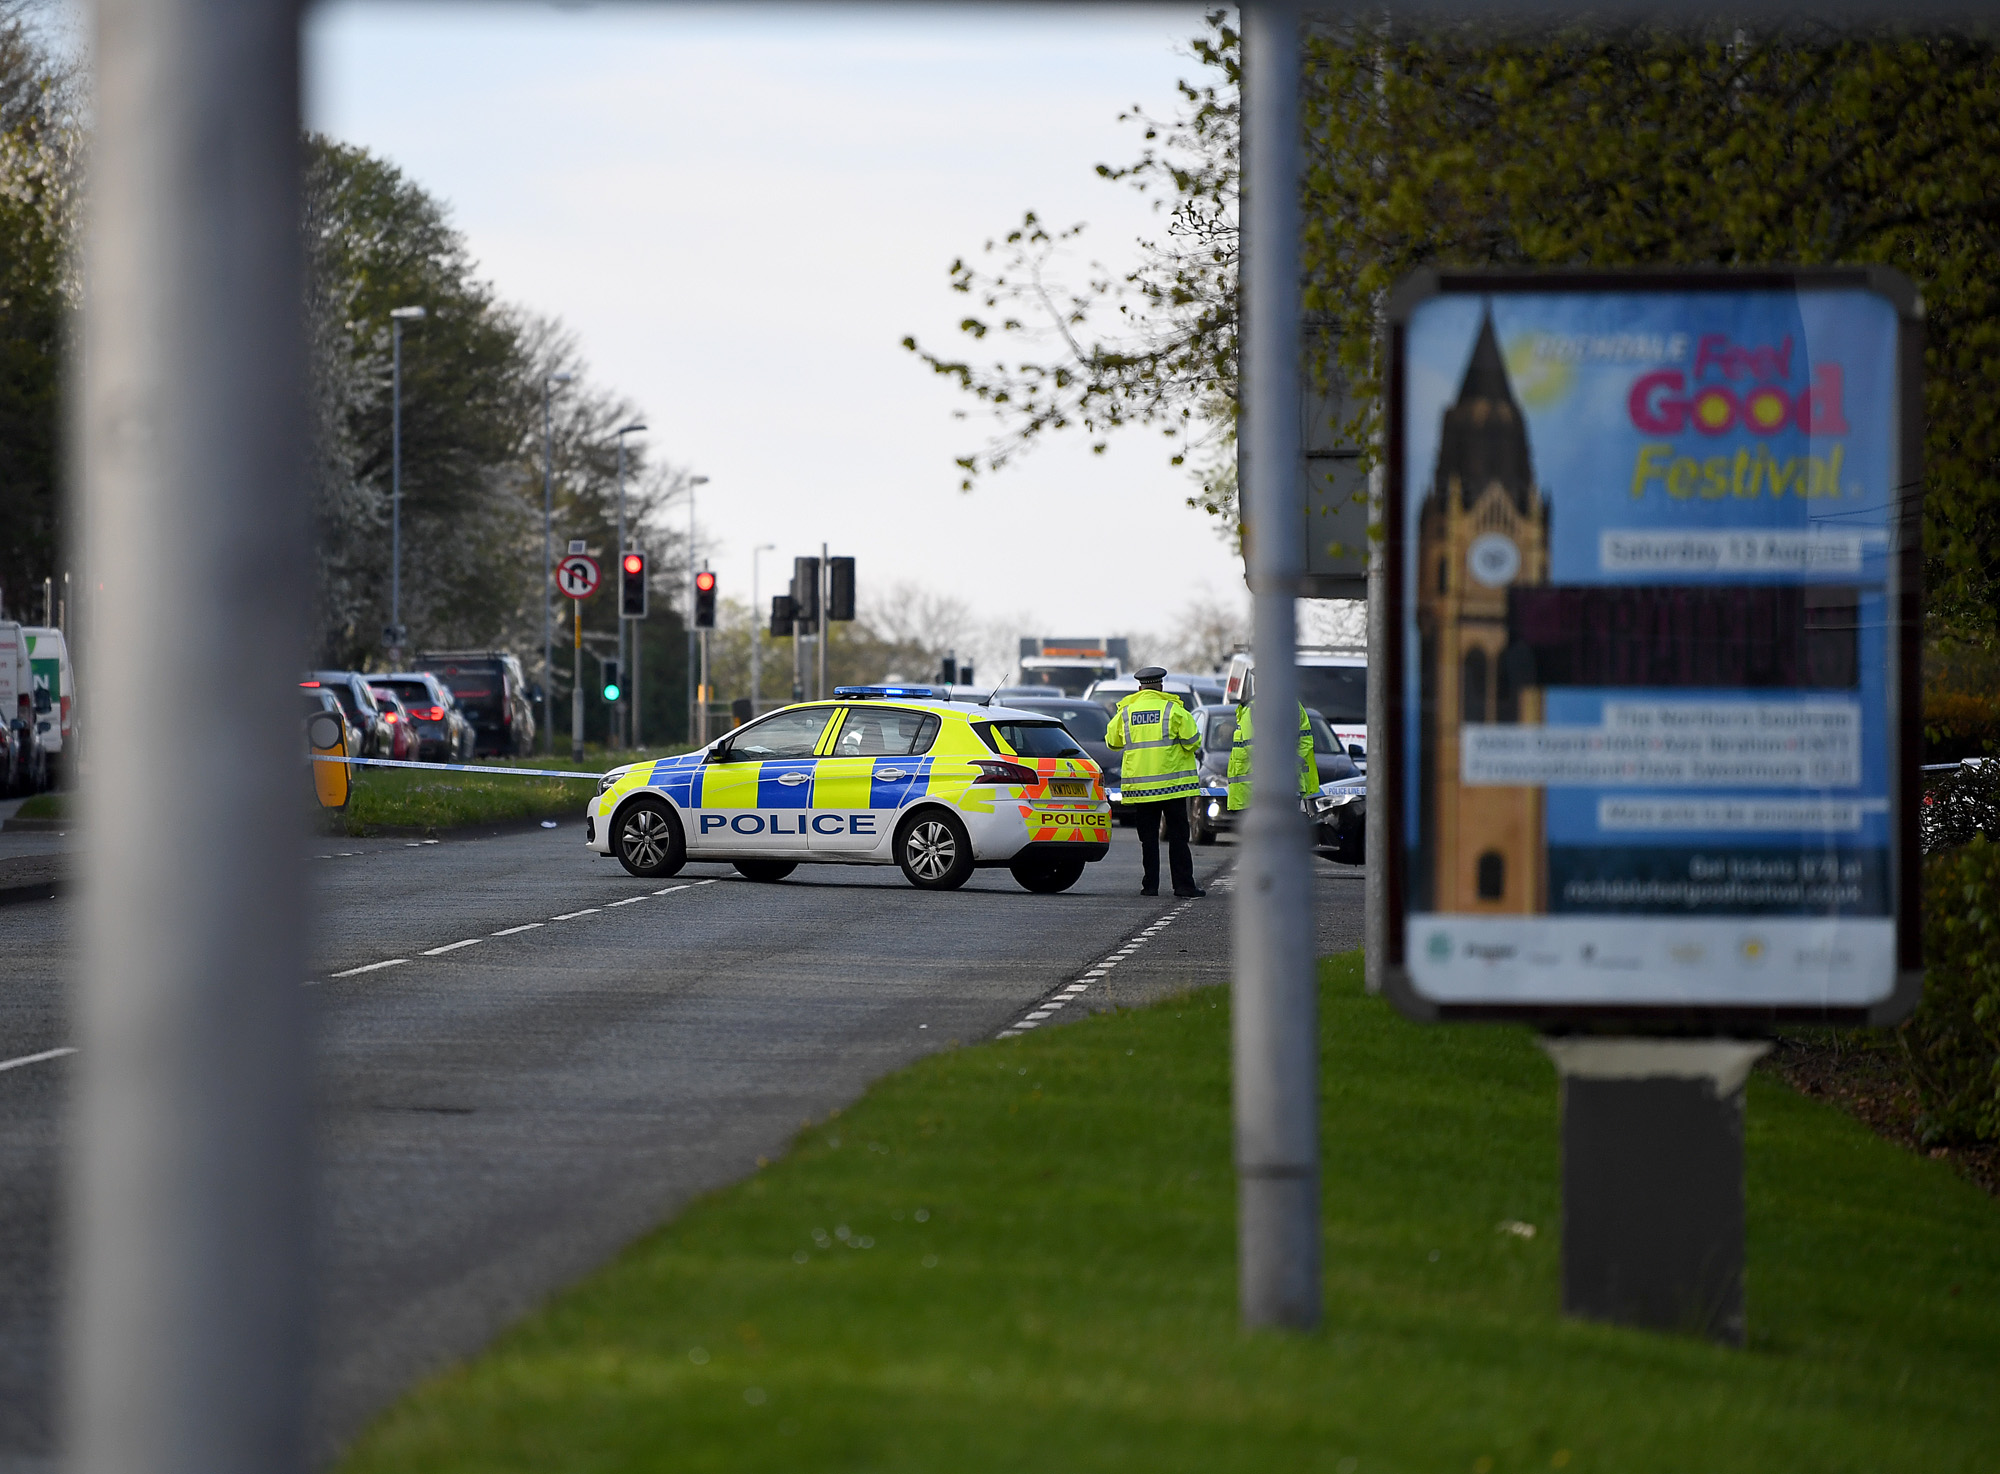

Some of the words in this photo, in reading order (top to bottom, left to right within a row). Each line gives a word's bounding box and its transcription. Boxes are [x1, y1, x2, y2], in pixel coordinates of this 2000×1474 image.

[1693, 333, 1794, 380] Feel
[1627, 362, 1848, 437] Good
[1630, 441, 1845, 500] Festival
[1132, 712, 1160, 725] POLICE
[1328, 787, 1347, 795] POLICE
[1348, 787, 1360, 795] LINE
[700, 814, 877, 835] POLICE
[1041, 813, 1106, 827] POLICE
